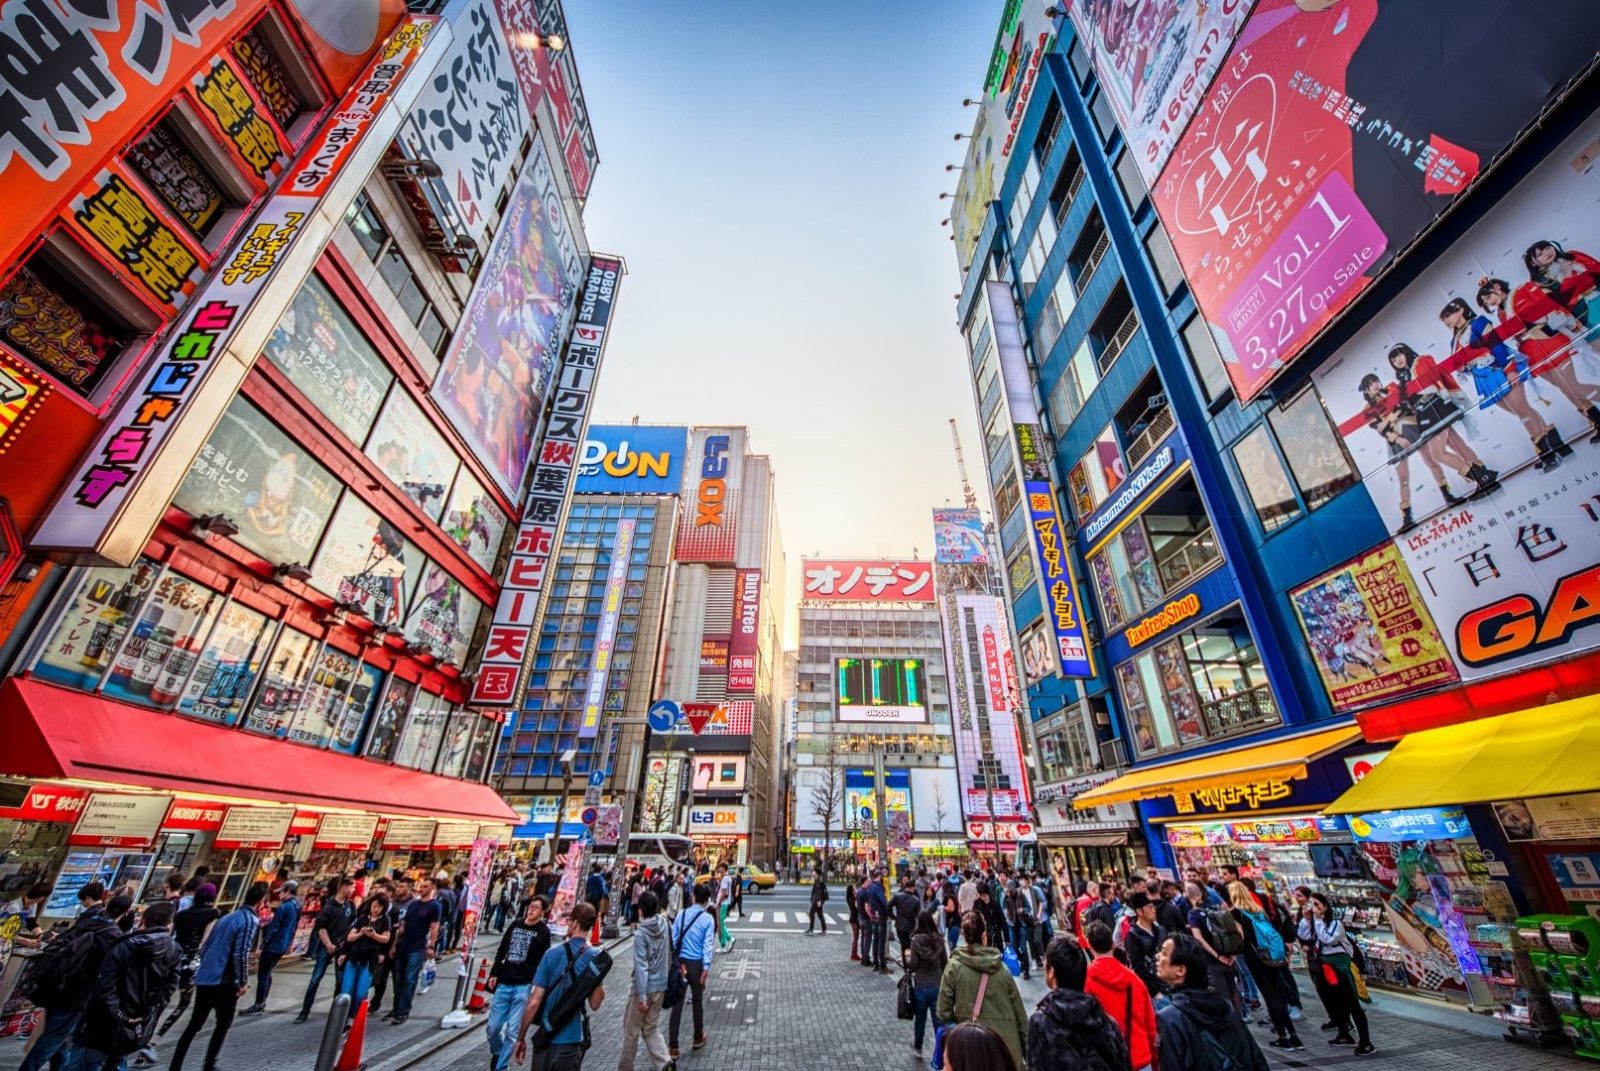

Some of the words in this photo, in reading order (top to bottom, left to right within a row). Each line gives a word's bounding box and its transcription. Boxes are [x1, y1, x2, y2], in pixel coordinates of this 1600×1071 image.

[357, 65, 402, 106] 買取り
[1147, 28, 1220, 163] 3.16(SAT)
[222, 223, 278, 286] 買います
[244, 211, 305, 284] フィギュア
[579, 261, 605, 322] PARADISE
[600, 261, 617, 303] HOBBY
[1246, 285, 1310, 370] 3.27
[1310, 290, 1336, 311] On
[1335, 247, 1373, 286] Sale
[74, 301, 238, 508] とれじゃらす
[744, 573, 760, 601] Duty
[806, 565, 931, 596] オノデン
[60, 604, 96, 656] ファレホ
[742, 602, 759, 634] Free
[1126, 623, 1147, 647] Tax
[1144, 612, 1167, 640] Free
[1166, 596, 1198, 624] Shop
[191, 702, 227, 720] いずれも
[170, 807, 203, 820] HOBBY
[202, 809, 224, 822] 天国
